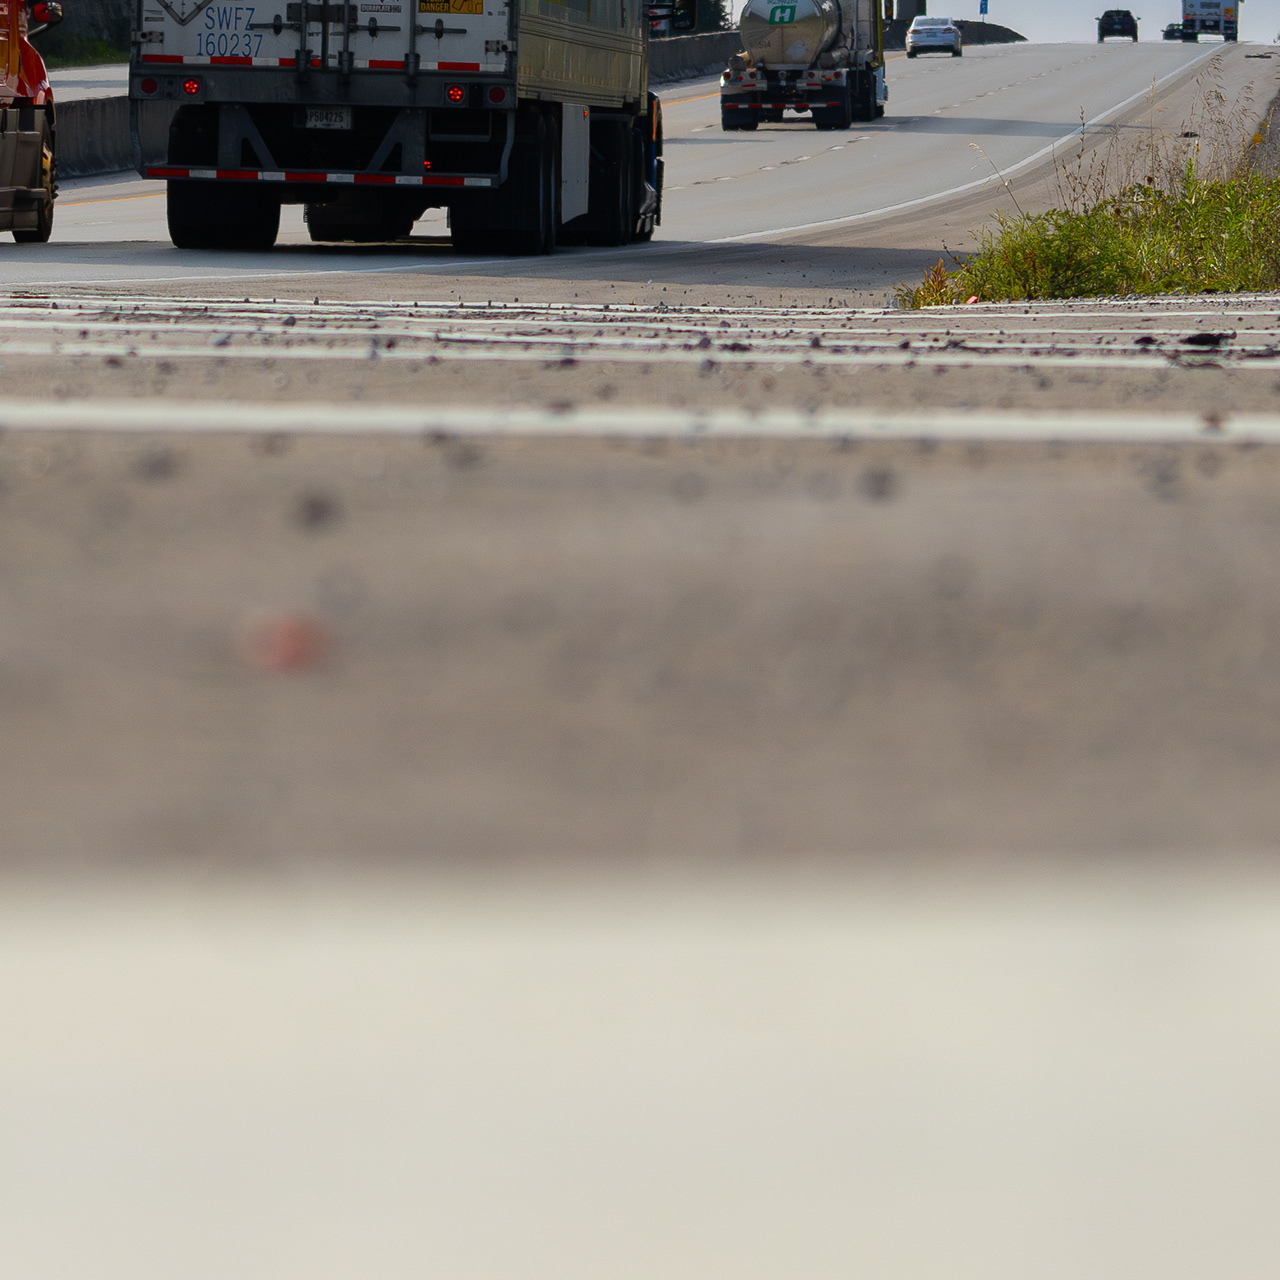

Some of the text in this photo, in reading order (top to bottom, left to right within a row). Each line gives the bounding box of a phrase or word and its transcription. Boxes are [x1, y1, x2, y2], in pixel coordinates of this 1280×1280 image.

[204, 6, 256, 31] SWFZ
[420, 2, 450, 12] DANGER
[196, 32, 263, 57] 160237
